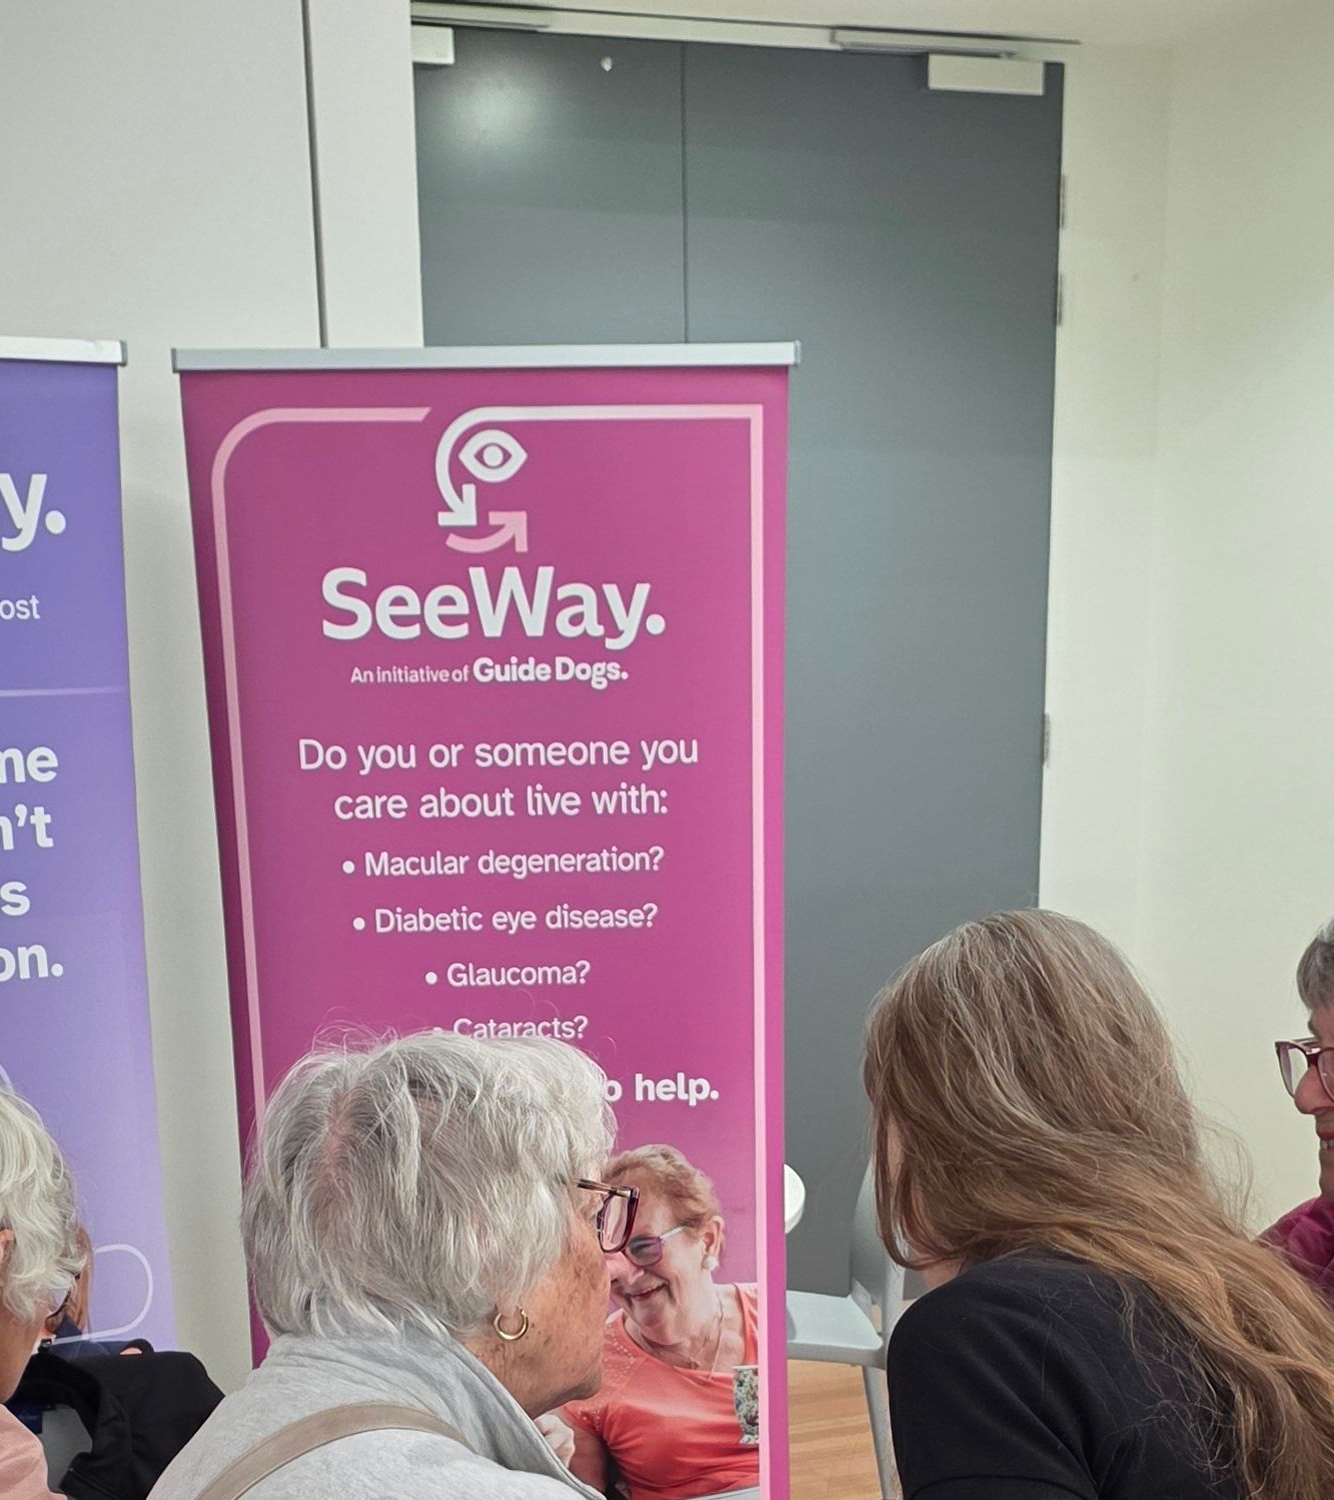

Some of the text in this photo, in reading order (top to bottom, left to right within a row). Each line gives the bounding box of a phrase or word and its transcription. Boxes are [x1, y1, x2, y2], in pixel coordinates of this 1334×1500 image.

[321, 565, 667, 650] SeeWay.
[350, 656, 629, 690] An initiative of Guide Dogs.
[298, 737, 700, 776] Do you or someone you
[334, 783, 669, 819] care about live with:
[364, 846, 665, 880] Macular degeneration?
[374, 902, 659, 935] Diabetic eye disease?
[446, 960, 592, 988] Glaucoma?
[452, 1015, 589, 1040] Cataracts?
[603, 1072, 720, 1107] o help.
